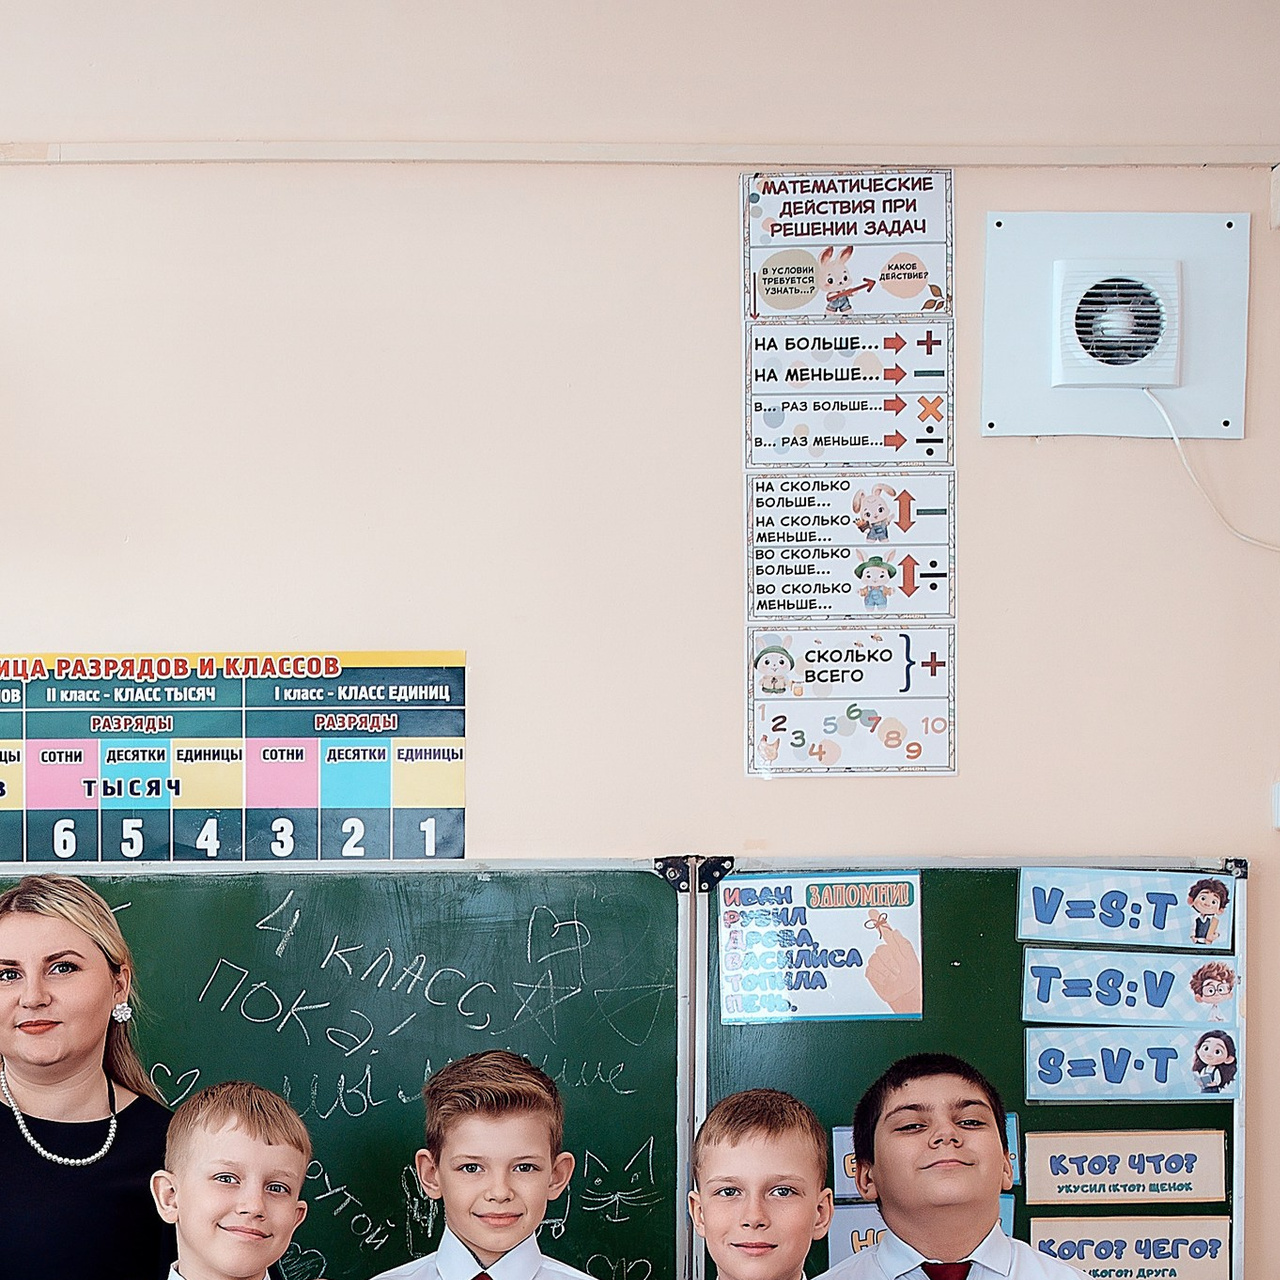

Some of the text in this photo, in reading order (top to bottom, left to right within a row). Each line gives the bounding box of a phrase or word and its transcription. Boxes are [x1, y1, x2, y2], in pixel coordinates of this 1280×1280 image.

[762, 176, 934, 195] МАТЕМАТИЧЕСКИЕ
[779, 198, 917, 218] ДЕЙСТВИЯ ПРИ
[770, 219, 926, 237] РЕШЕНИИ ЗАДАЧ
[762, 266, 814, 275] В УСЛОВИИ
[888, 262, 917, 271] КАКОЕ
[762, 276, 815, 285] ТРЕБУЕТСЯ
[879, 271, 929, 281] ДЕЙСТВИЕ?
[765, 286, 815, 295] УЗНАТЬ...?
[755, 336, 879, 350] НА БОЛЬШЕ...
[755, 367, 880, 382] НА МЕНЬШЕ...
[755, 401, 882, 412] В... РАЗ БОЛЬШЕ...
[755, 436, 883, 447] В... РАЗ МЕНЬШЕ...
[756, 480, 850, 492] НА СКОЛЬКО
[756, 497, 831, 508] БОЛЬШЕ...
[756, 515, 851, 527] НА СКОЛЬКО
[756, 531, 832, 543] МЕНЬШЕ...
[756, 548, 851, 560] ВО СКОЛЬКО
[756, 564, 830, 576] БОЛЬШЕ...
[756, 583, 852, 595] ВО СКОЛЬКО
[756, 599, 832, 610] МЕНЬШЕ...
[805, 649, 892, 663] СКОЛЬКО
[56, 657, 190, 680] РАЗРЯДОВ
[199, 657, 218, 678] И
[224, 656, 341, 678] КЛАССОВ
[805, 669, 863, 683] ВСЕГО
[47, 688, 56, 702] II
[60, 688, 100, 702] класс
[114, 687, 161, 702] КЛАСС
[164, 686, 216, 702] ТЫСЯЧ
[283, 687, 324, 700] класс
[338, 686, 385, 700] КЛАСС
[388, 685, 450, 701] ЕДИНИЦ
[91, 716, 173, 733] РАЗРЯДЫ
[315, 714, 398, 731] РАЗРЯДЫ
[758, 703, 947, 761] 1 2 3 4 5 6 7 8 9 10
[41, 750, 82, 763] СОТНИ
[106, 749, 165, 763] ДЕСЯТКИ
[176, 748, 243, 762] ЕДИНИЦЫ
[262, 748, 304, 761] СОТНИ
[326, 748, 386, 762] ДЕСЯТКИ
[397, 748, 464, 762] ЕДИНИЦЫ
[83, 780, 181, 797] ТЫСЯЧ
[53, 819, 77, 858] 6
[120, 818, 143, 858] 5
[196, 818, 220, 857] 4
[271, 818, 295, 857] 3
[341, 818, 364, 857] 2
[420, 818, 436, 857] 1
[723, 885, 793, 906] ИВАН
[809, 883, 909, 908] ЗАПОМНИ!
[256, 889, 300, 957] 4
[723, 906, 807, 928] РУБИЛ
[725, 948, 863, 971] ВАСИЛИСА
[725, 970, 827, 992] ТОПИЛА
[1049, 1153, 1198, 1176] КТО? ЧТО?
[1057, 1184, 1106, 1194] УКУСИЛ
[1149, 1182, 1193, 1193] ЩЕНОК
[1038, 1238, 1222, 1261] КОГО? ЧЕГО?
[1136, 1268, 1177, 1280] ДРУГА
